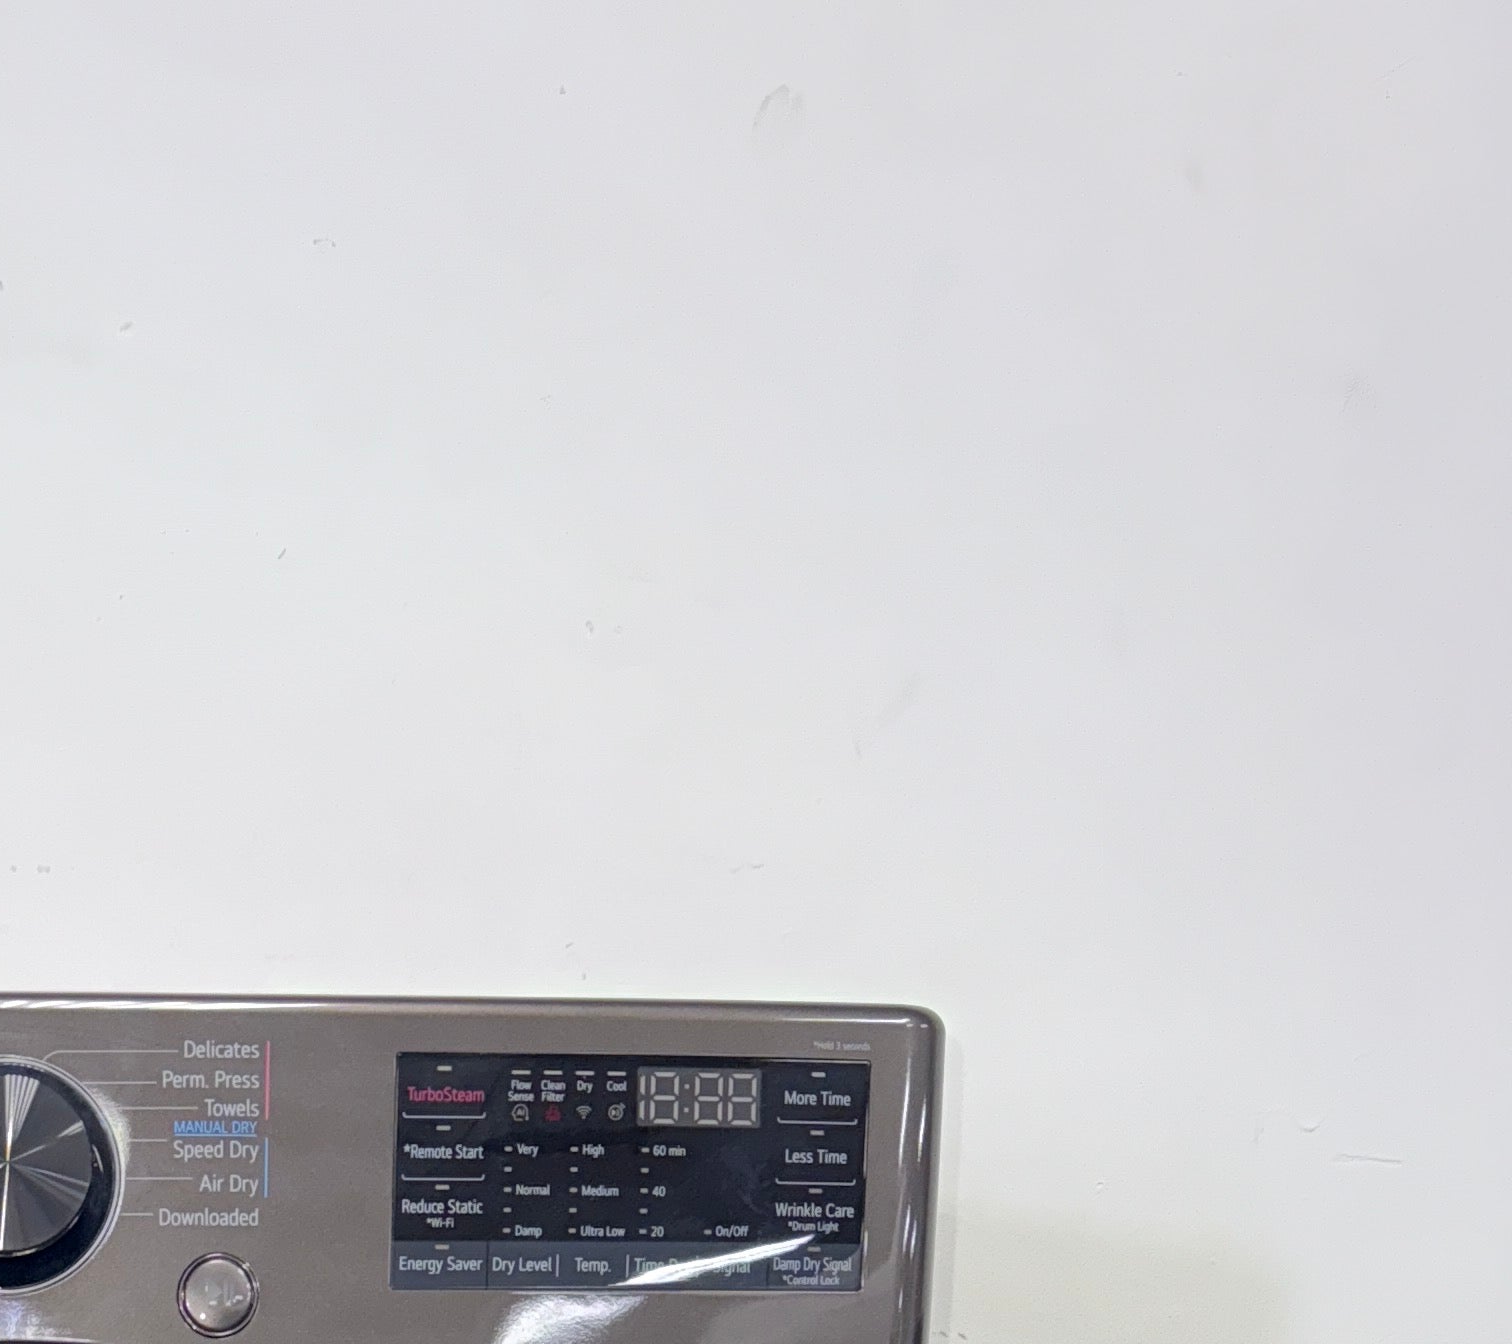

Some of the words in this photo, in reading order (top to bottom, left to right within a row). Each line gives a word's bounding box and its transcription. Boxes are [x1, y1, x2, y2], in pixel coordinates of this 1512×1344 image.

[183, 1040, 260, 1058] Delicates
[162, 1070, 209, 1088] Perm.
[215, 1070, 260, 1088] Press
[510, 1079, 532, 1090] Flow
[540, 1080, 566, 1091] Clean
[576, 1080, 593, 1093] Dry
[606, 1080, 627, 1091] Cool
[407, 1086, 485, 1102] TurboSteam
[508, 1091, 534, 1102] Sense
[541, 1091, 565, 1102] Filter
[784, 1090, 817, 1105] More
[820, 1091, 852, 1107] Time
[204, 1098, 260, 1117] Towels
[173, 1121, 227, 1134] MANUAL
[231, 1121, 257, 1134] DRY
[173, 1140, 224, 1162] Speed
[230, 1140, 259, 1163] Dry
[455, 1144, 484, 1159] Start
[516, 1143, 539, 1158] Very
[581, 1143, 605, 1159] High
[652, 1145, 666, 1157] 60
[668, 1146, 686, 1157] min
[785, 1148, 813, 1163] Less
[817, 1149, 848, 1164] Time
[199, 1174, 224, 1192] Air
[229, 1174, 259, 1197] Dry
[515, 1184, 550, 1196] Normal
[581, 1185, 619, 1197] Medium
[652, 1185, 666, 1197] 40
[402, 1198, 444, 1214] Reduce
[448, 1199, 483, 1214] Static
[775, 1202, 822, 1217] Wrinkle
[825, 1203, 855, 1218] Care
[159, 1208, 259, 1226] Downloaded
[514, 1225, 542, 1239] Damp
[580, 1225, 604, 1237] Ultra
[606, 1226, 626, 1237] Low
[651, 1226, 664, 1237] 20
[715, 1225, 749, 1238] On/Off
[817, 1221, 839, 1234] Light
[399, 1256, 443, 1274] Energy
[447, 1256, 483, 1271] Saver
[492, 1256, 515, 1275] Dry
[518, 1256, 552, 1272] Level
[574, 1257, 611, 1276] Temp.
[773, 1257, 800, 1274] Damp
[803, 1257, 820, 1275] Dry
[823, 1257, 852, 1275] Signal
[820, 1275, 840, 1286] Lock
